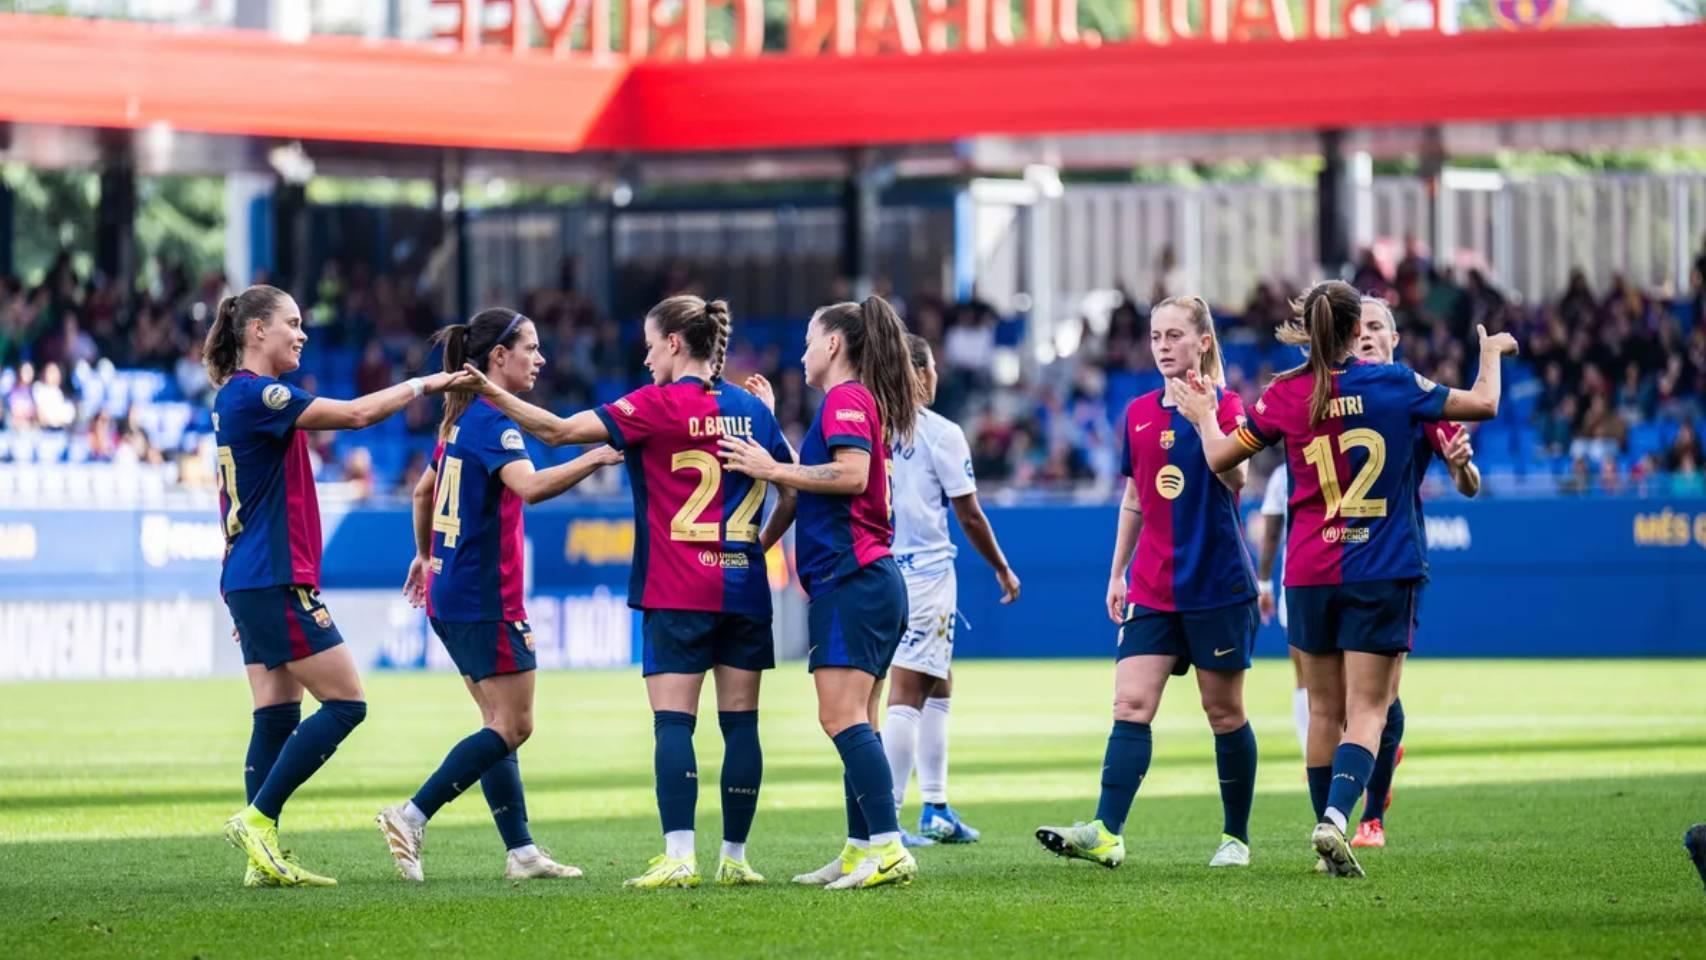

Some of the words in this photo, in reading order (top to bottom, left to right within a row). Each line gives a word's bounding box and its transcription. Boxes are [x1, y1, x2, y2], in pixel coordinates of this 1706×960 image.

[433, 455, 463, 548] 4
[670, 449, 768, 543] 22
[1302, 427, 1387, 521] 12
